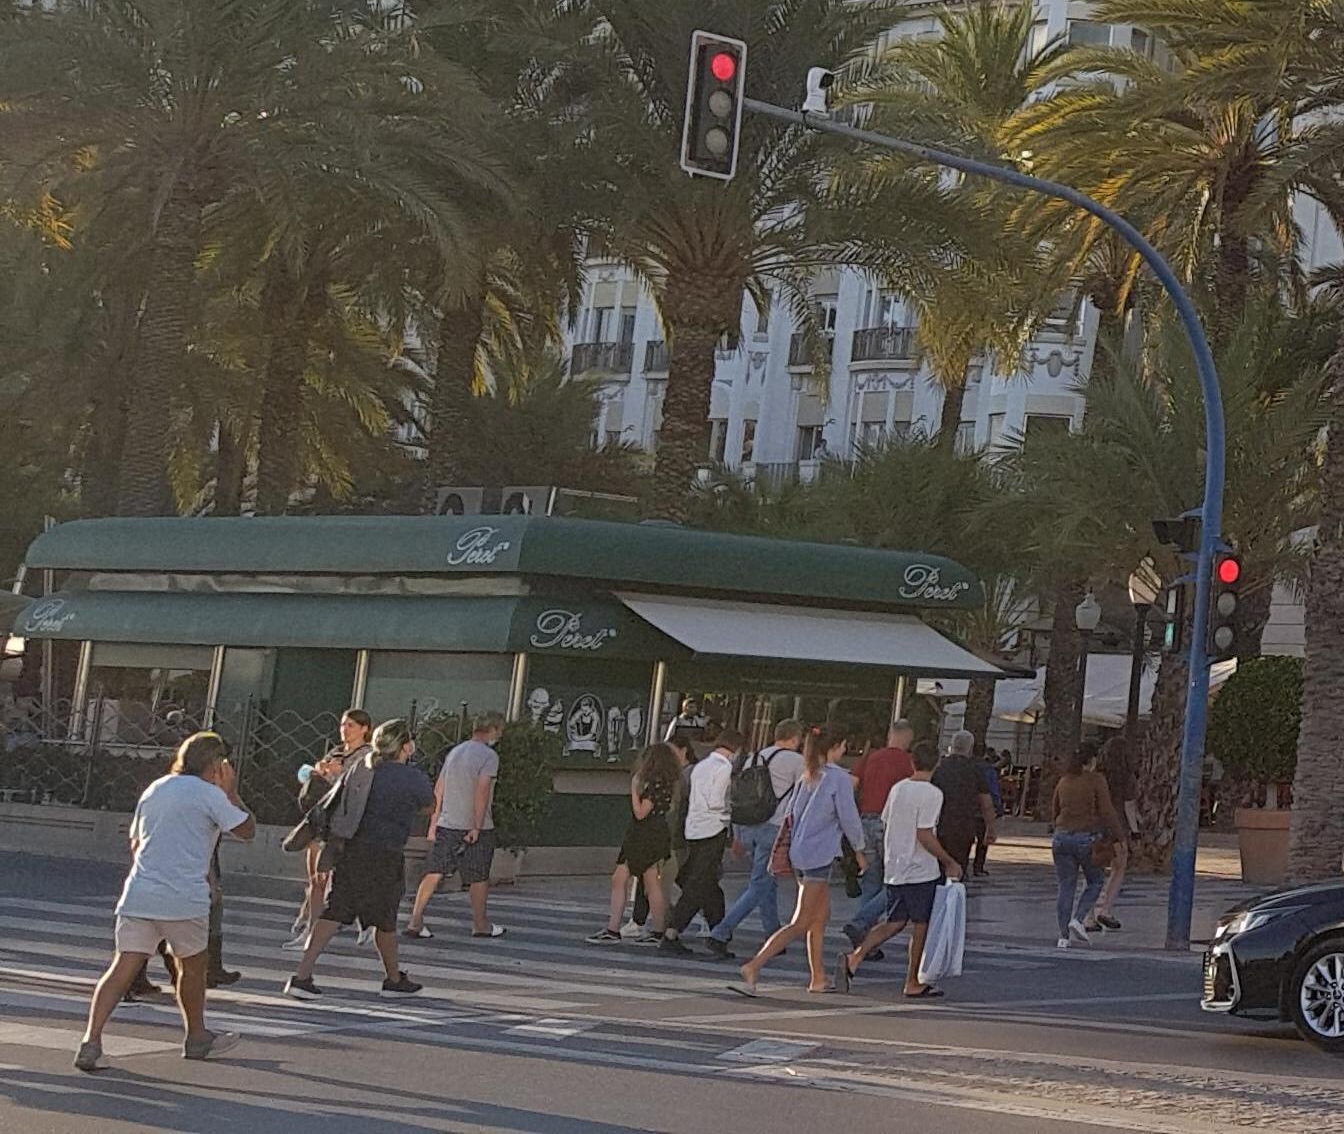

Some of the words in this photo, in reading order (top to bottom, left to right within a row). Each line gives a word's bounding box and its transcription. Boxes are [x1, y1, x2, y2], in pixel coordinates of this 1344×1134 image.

[447, 527, 503, 565] Peret
[899, 564, 962, 601] Peret
[530, 609, 609, 650] Peret
